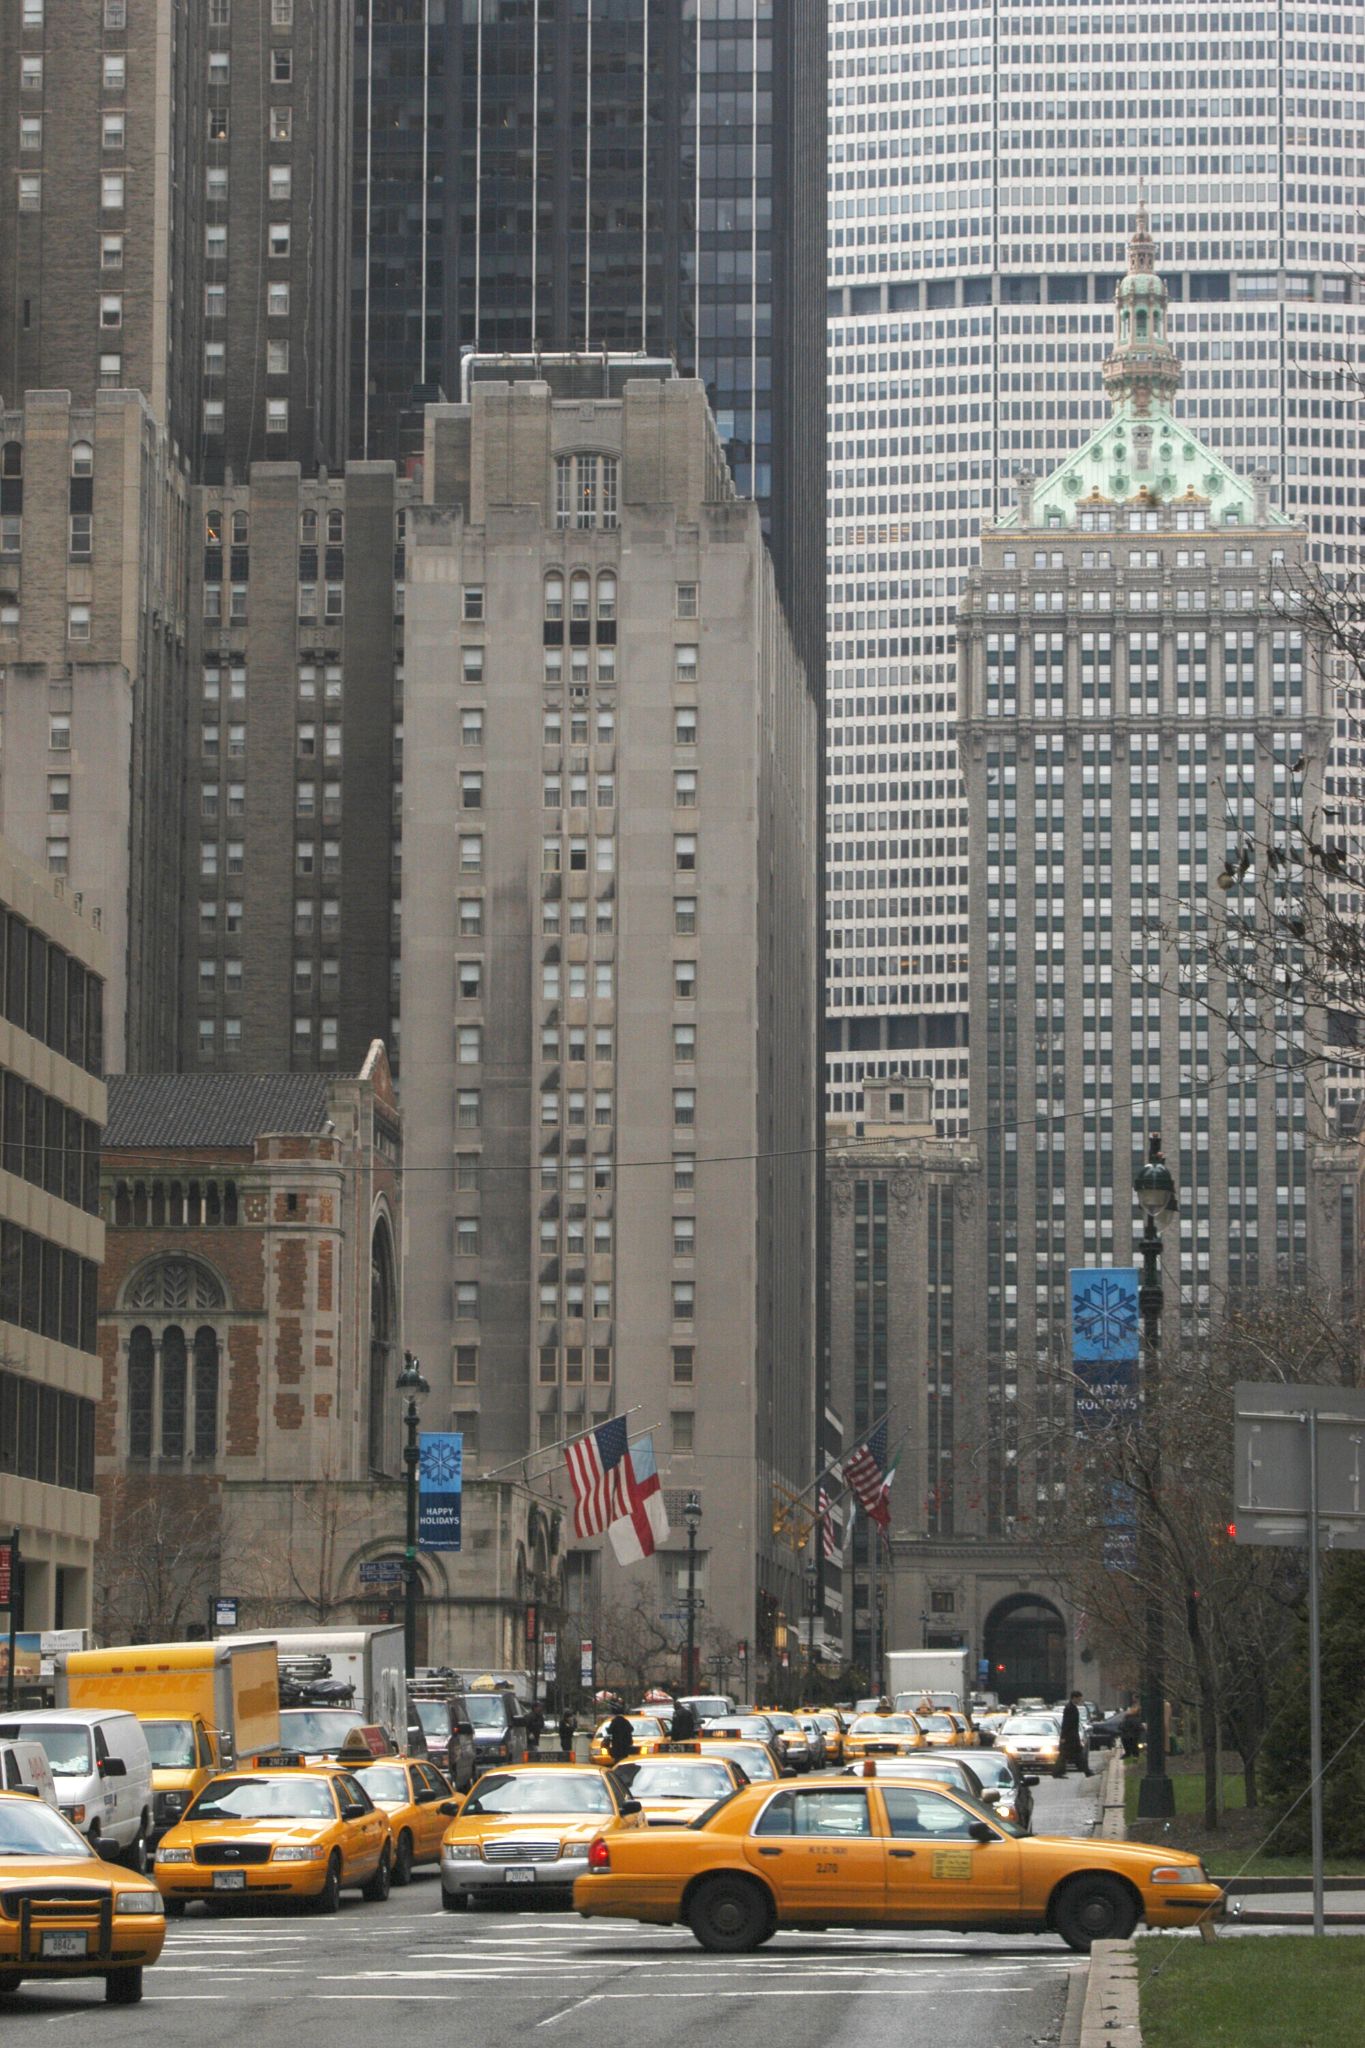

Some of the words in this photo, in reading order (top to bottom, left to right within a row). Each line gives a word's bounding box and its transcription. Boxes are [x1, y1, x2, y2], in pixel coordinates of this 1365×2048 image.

[426, 1507, 454, 1516] HAPPY
[419, 1516, 460, 1525] HOLIDAYS
[77, 1674, 207, 1699] PENSKE
